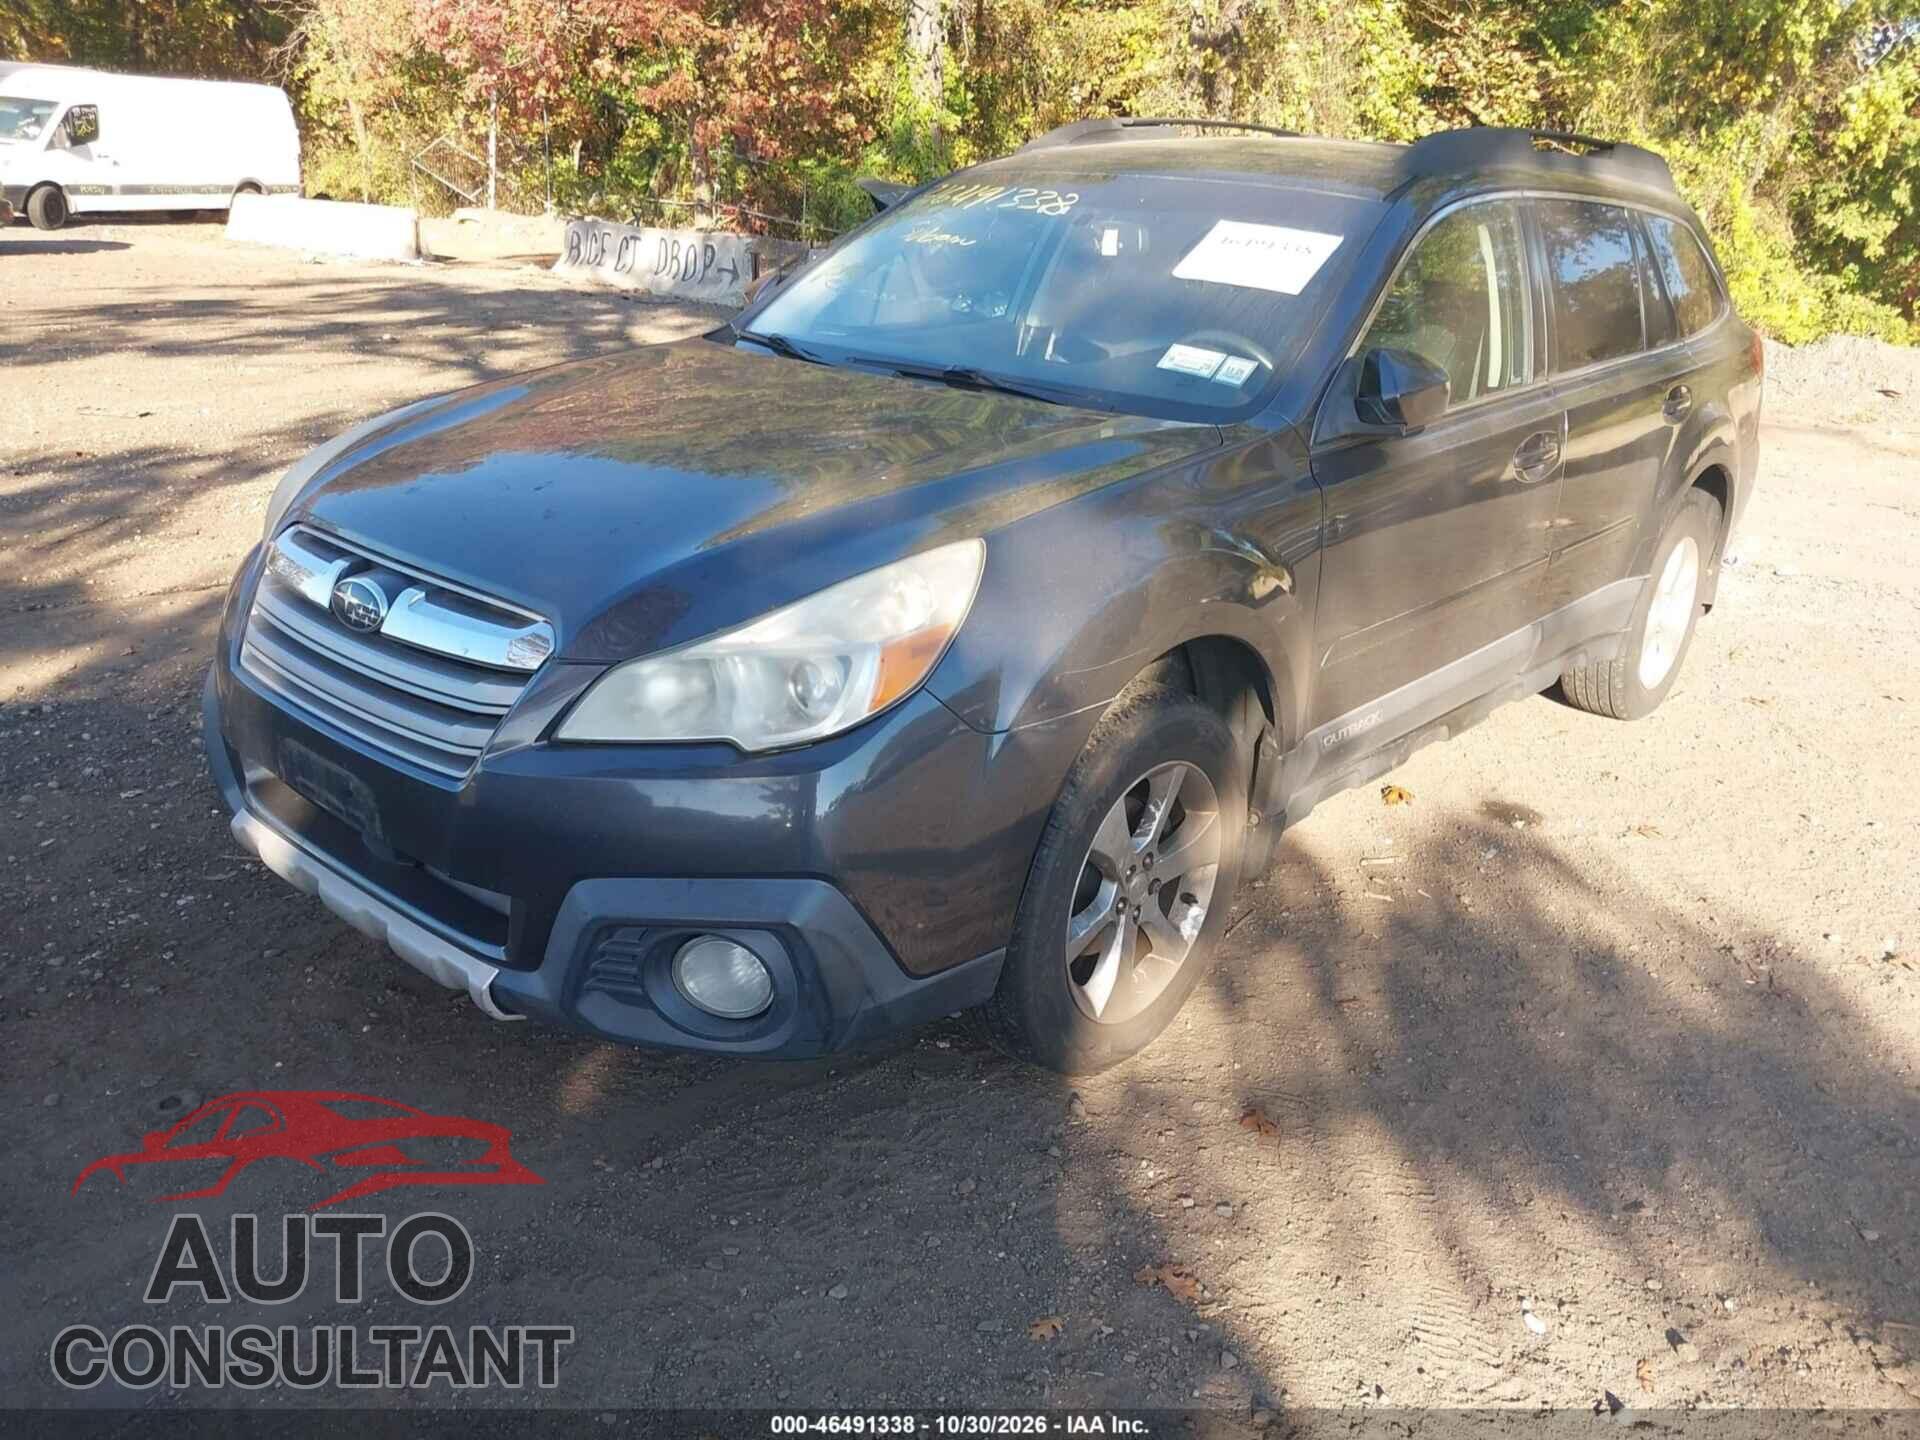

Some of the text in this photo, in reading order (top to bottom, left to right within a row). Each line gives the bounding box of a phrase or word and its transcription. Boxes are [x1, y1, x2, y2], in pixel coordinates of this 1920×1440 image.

[564, 228, 716, 284] RICE CT DROP
